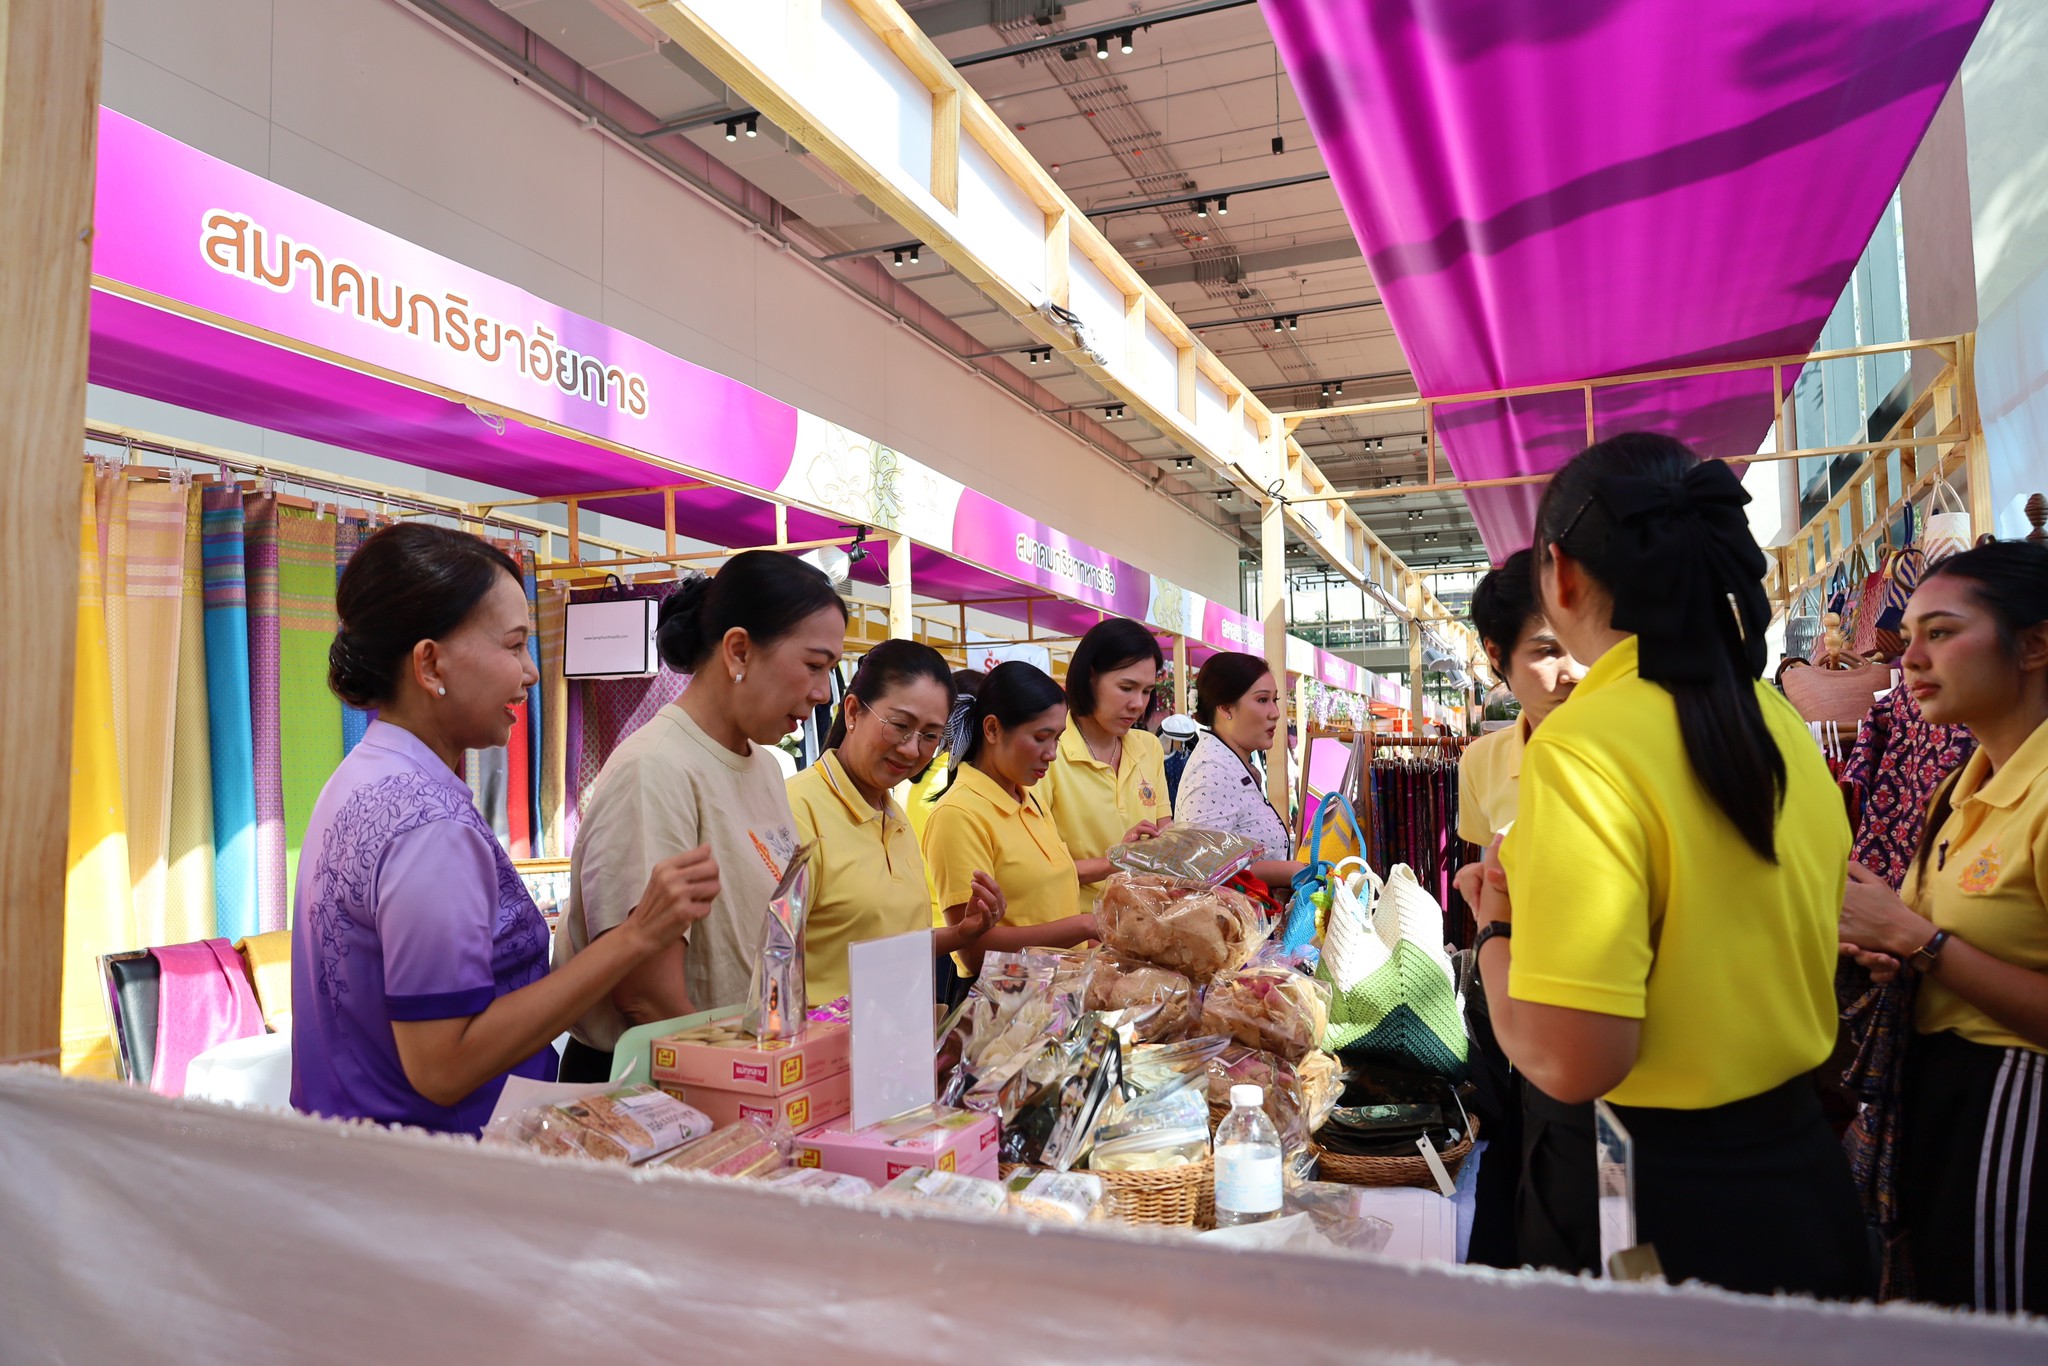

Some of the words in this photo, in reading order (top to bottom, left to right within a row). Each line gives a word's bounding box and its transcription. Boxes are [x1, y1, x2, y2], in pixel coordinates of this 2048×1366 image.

[203, 211, 648, 418] สมาคมภริยาอัยการ
[1017, 534, 1115, 595] สมาคมภริยาทหารเรือ
